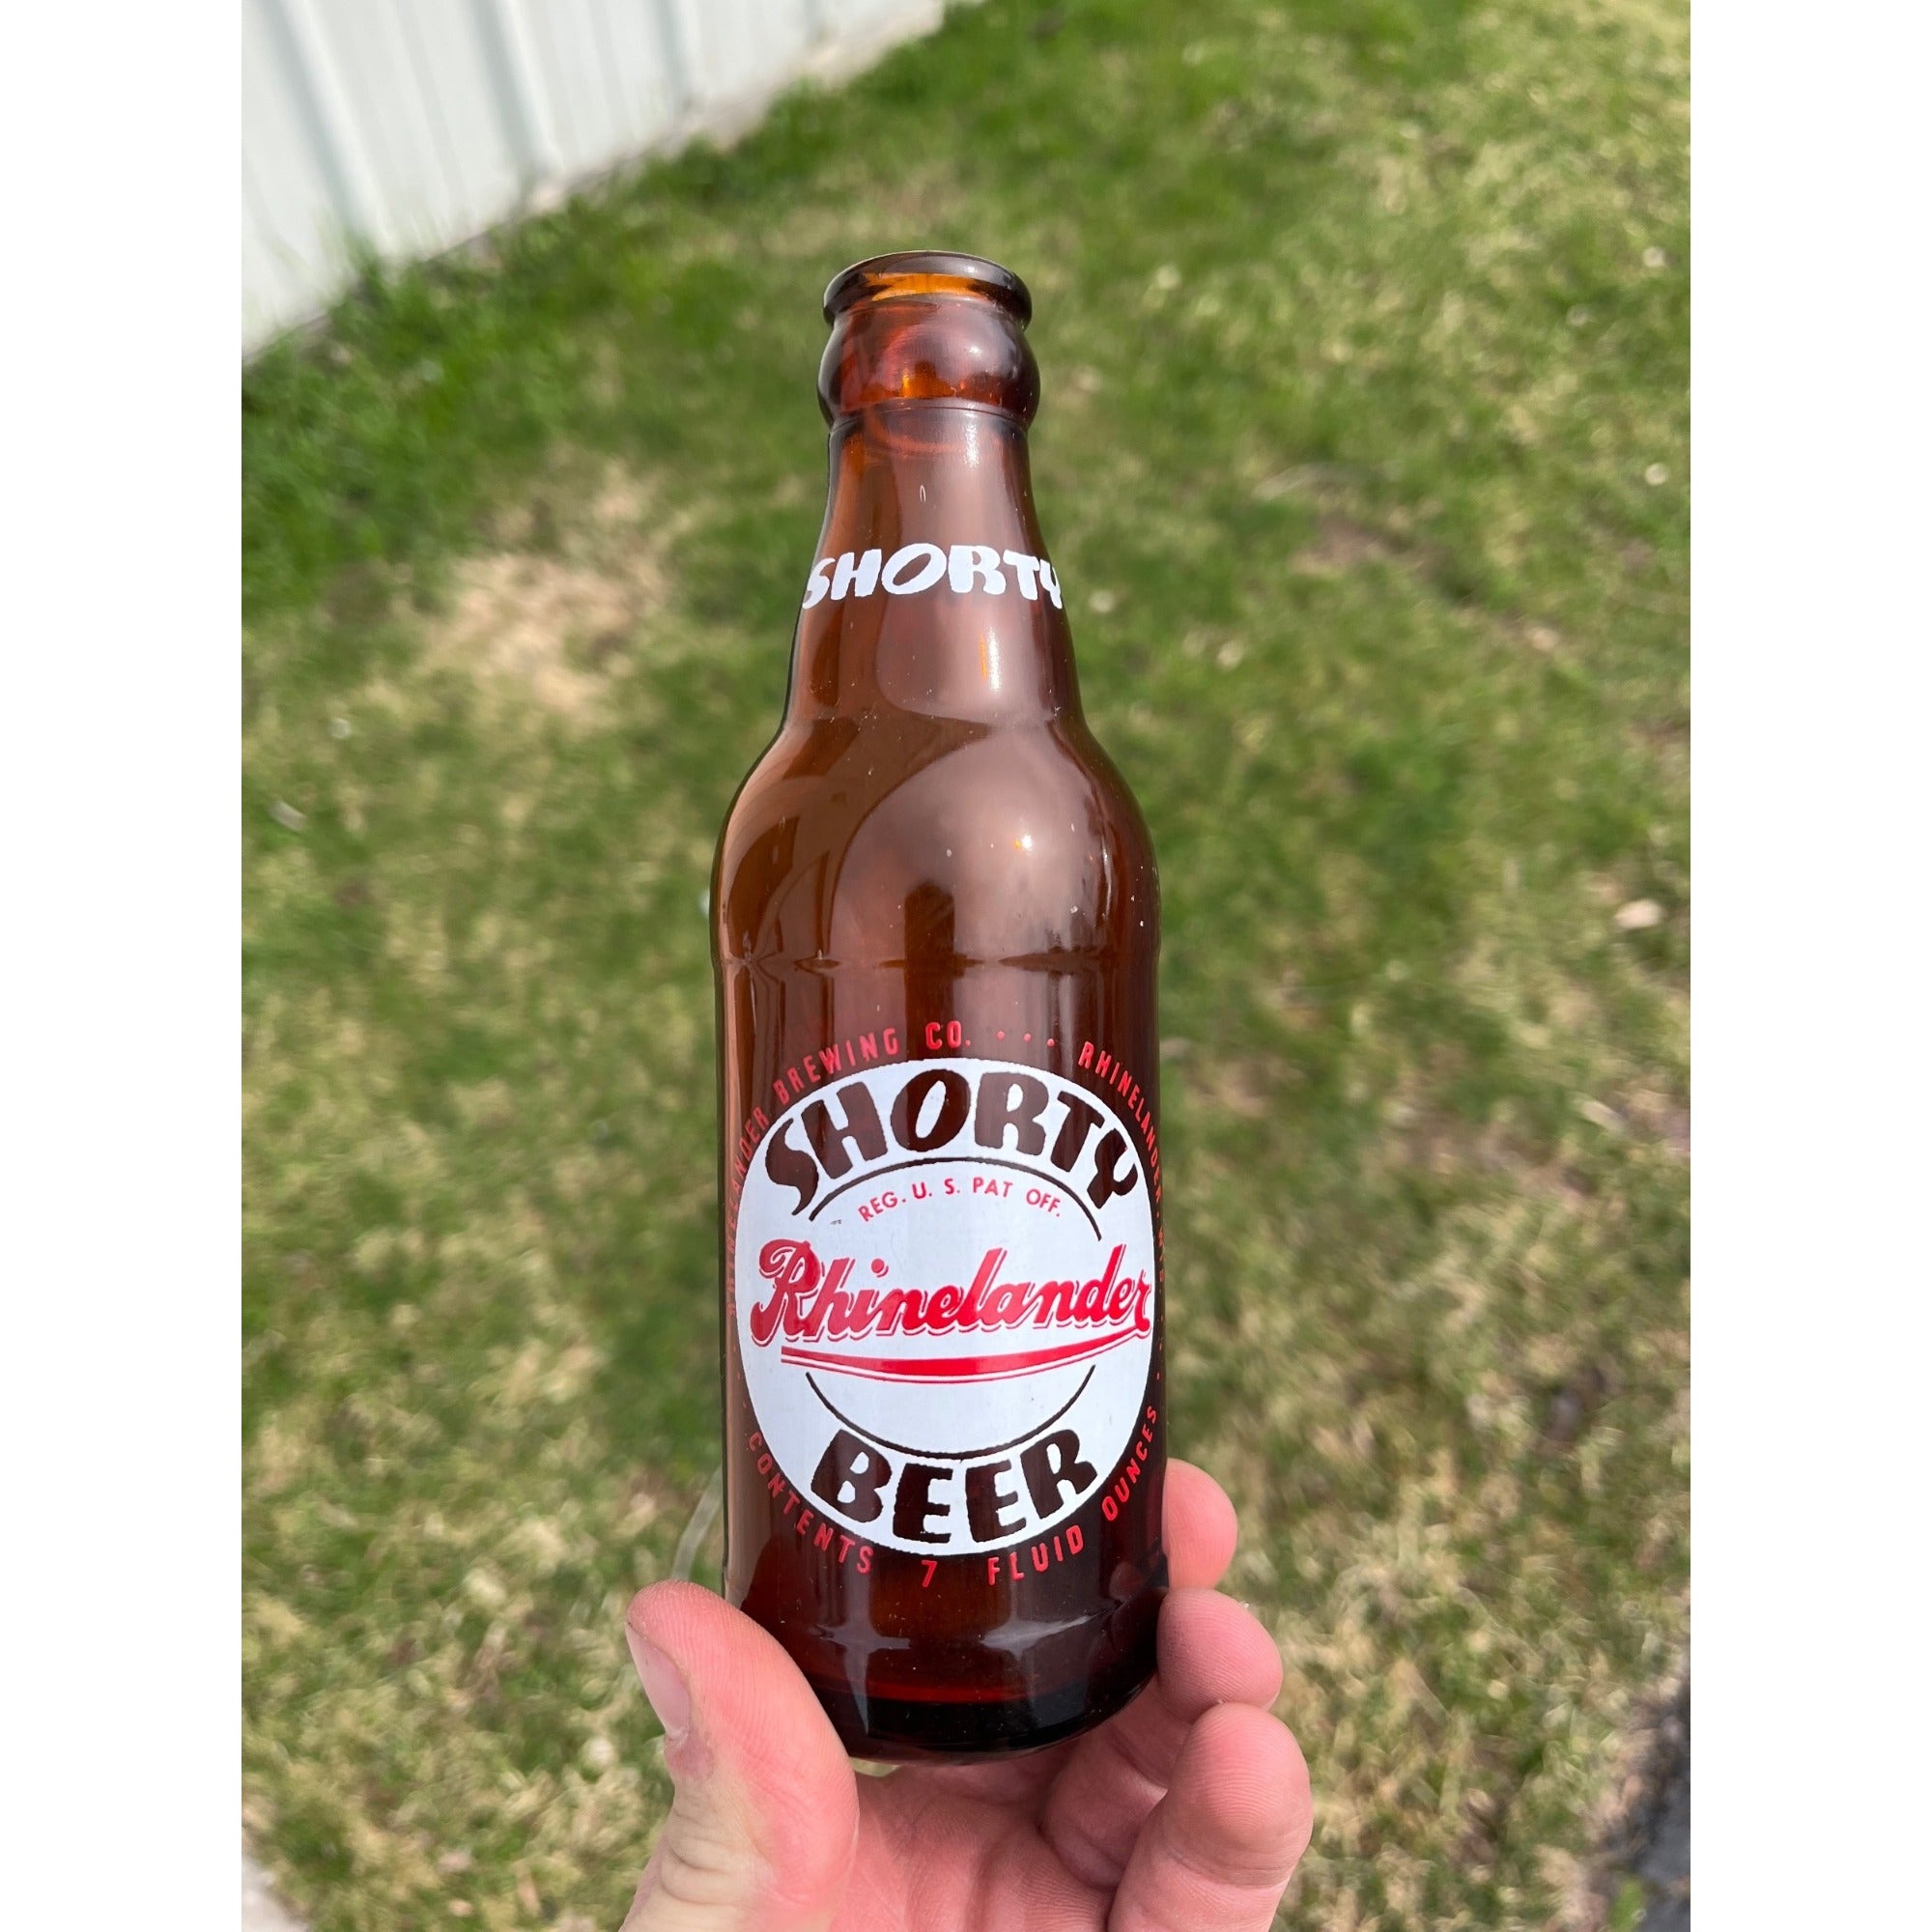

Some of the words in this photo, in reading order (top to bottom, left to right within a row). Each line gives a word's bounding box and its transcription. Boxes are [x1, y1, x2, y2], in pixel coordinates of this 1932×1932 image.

[802, 543, 1063, 610] SHORTY
[773, 1027, 900, 1106] BREWING
[924, 1020, 971, 1050] CO.
[765, 1068, 1139, 1216] SHORTY
[858, 1191, 907, 1222] REG.
[912, 1181, 933, 1200] U.
[944, 1178, 961, 1195] S.
[973, 1177, 1013, 1198] PAT
[1026, 1188, 1062, 1217] OFF.
[751, 1238, 1152, 1346] Rhinelander
[748, 1432, 874, 1576] CONTENTS
[922, 1559, 938, 1588] 7
[987, 1523, 1085, 1586] FLUID
[1101, 1406, 1157, 1521] OUNCES
[810, 1429, 1098, 1544] BEER
